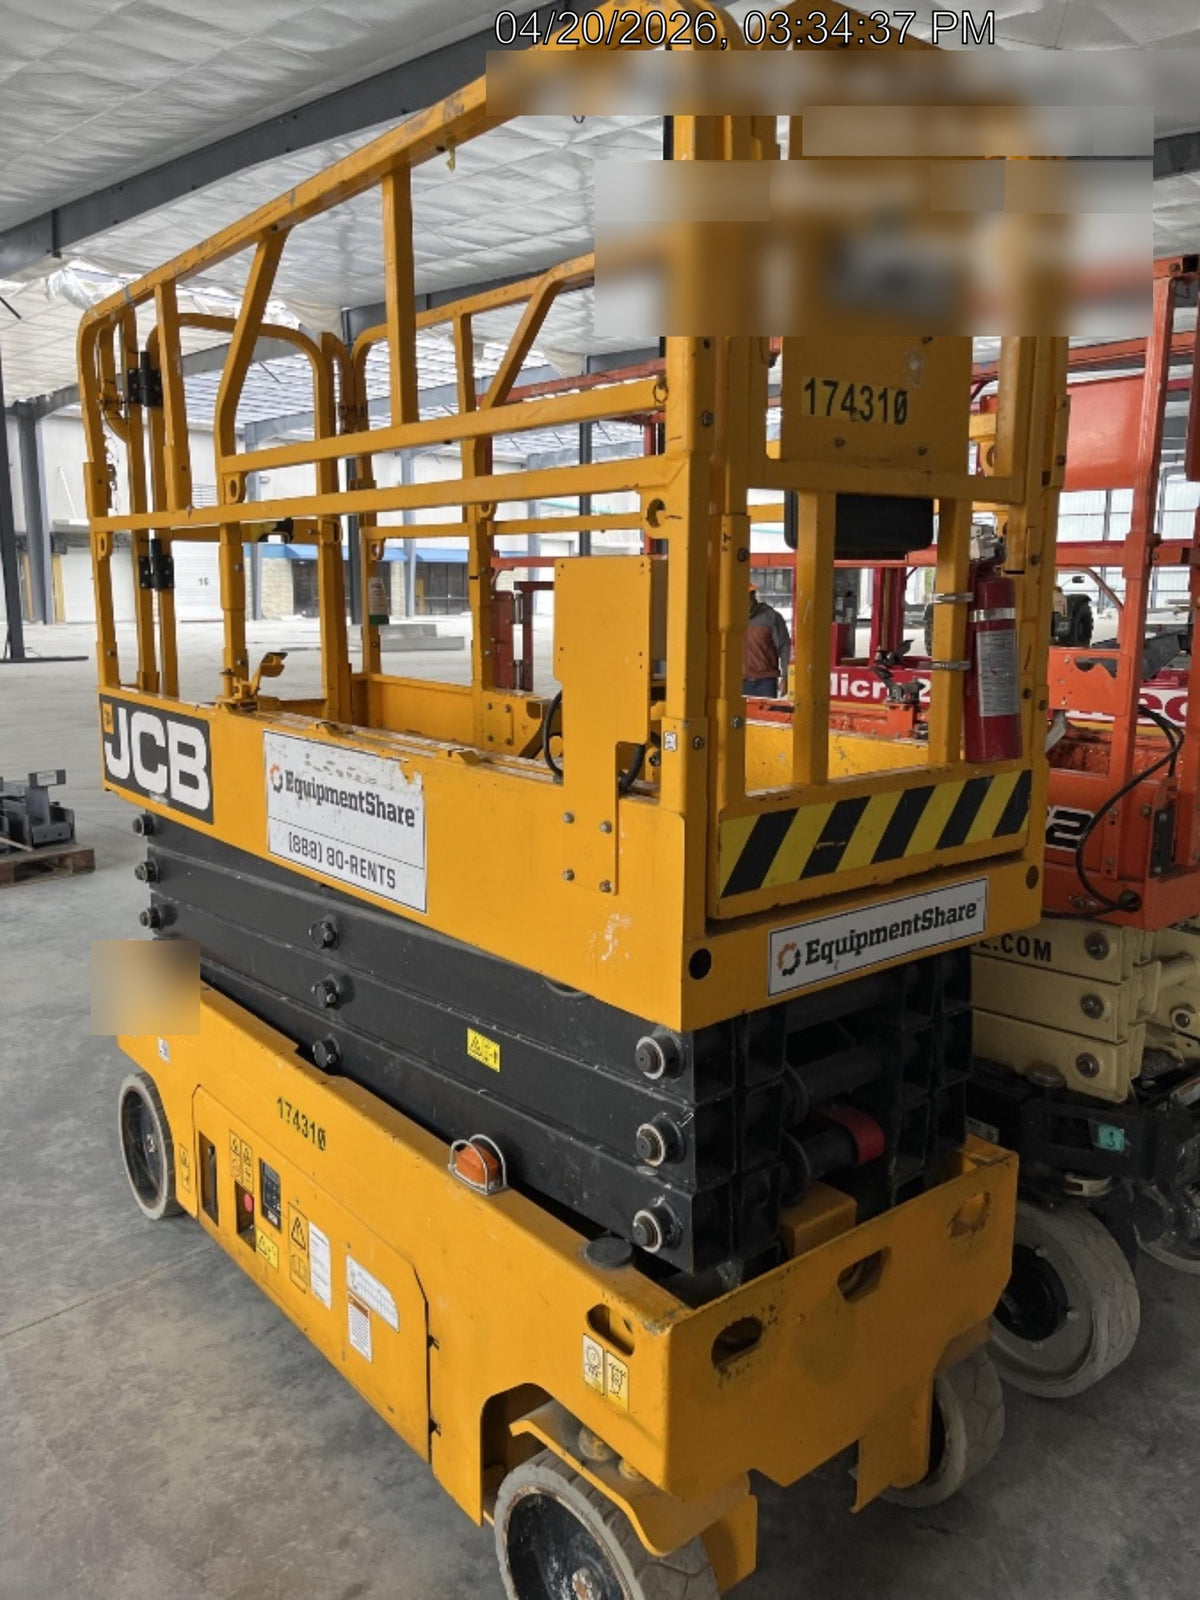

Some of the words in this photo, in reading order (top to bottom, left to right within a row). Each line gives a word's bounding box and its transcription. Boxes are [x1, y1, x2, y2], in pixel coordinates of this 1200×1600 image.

[805, 377, 908, 425] 174310
[104, 706, 210, 811] JCB
[285, 769, 415, 828] EquipmentShare
[326, 847, 396, 889] 80-RENTS
[805, 902, 977, 965] EquipmentShare
[276, 1097, 326, 1151] 174310
